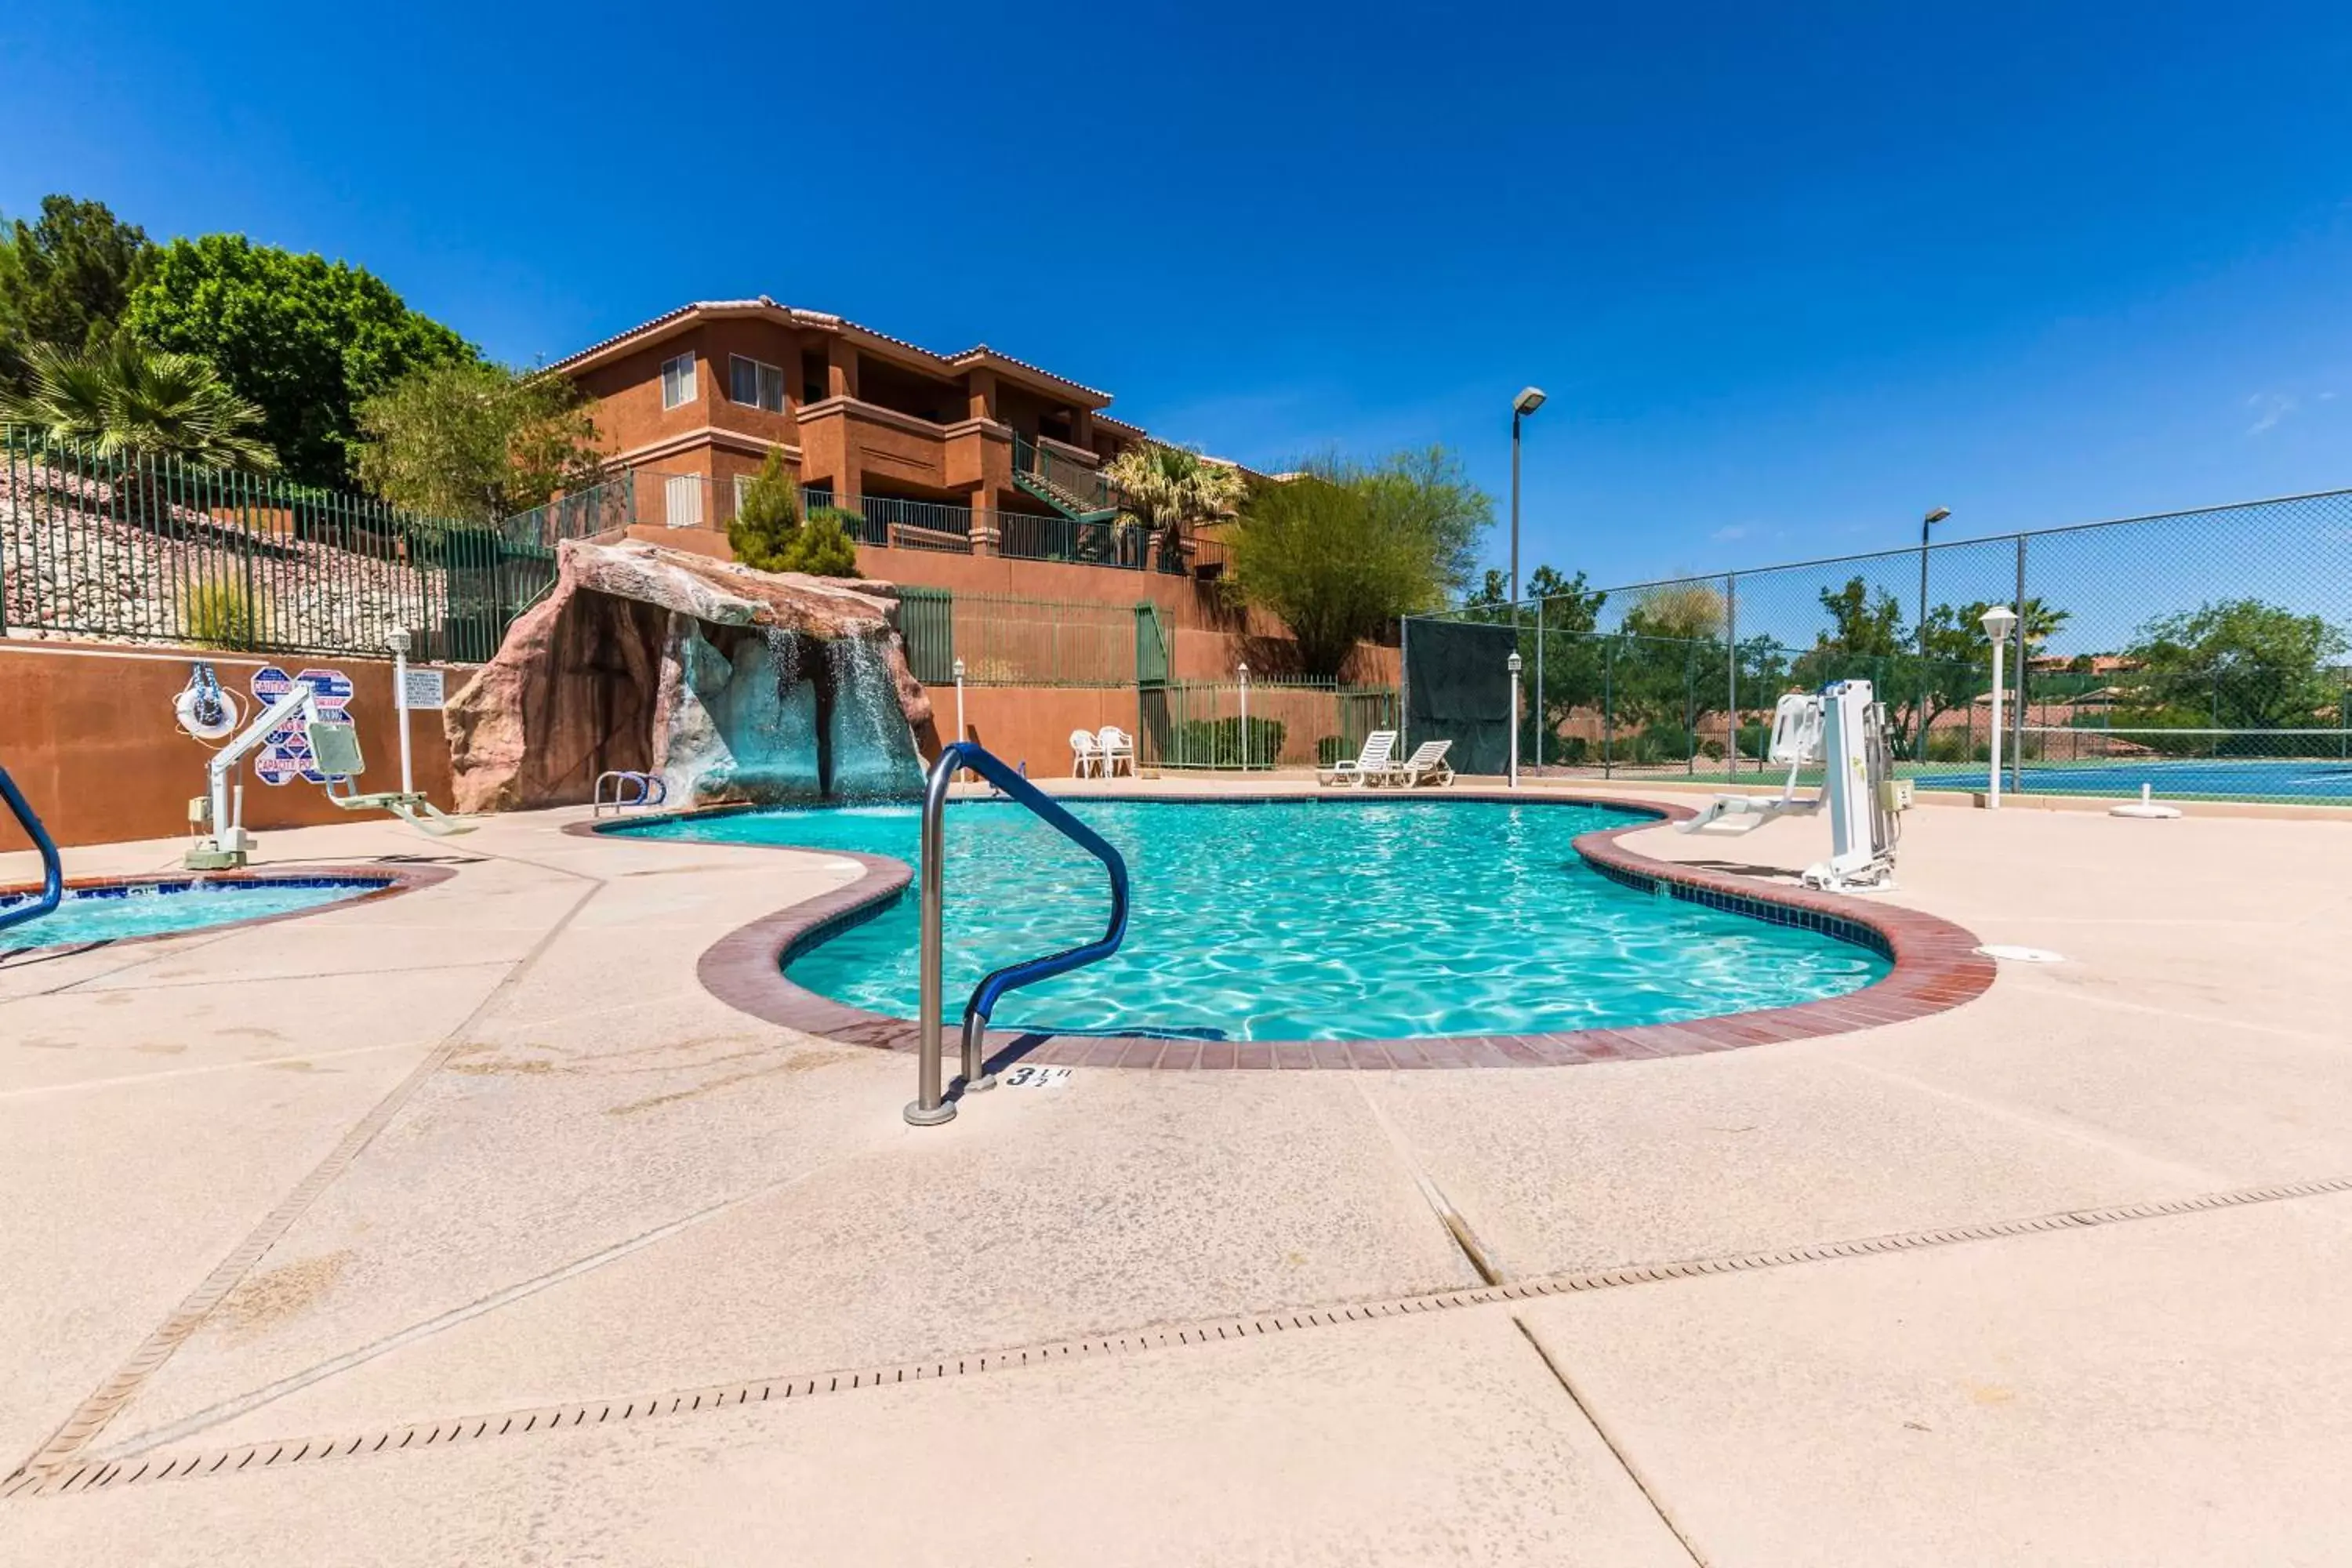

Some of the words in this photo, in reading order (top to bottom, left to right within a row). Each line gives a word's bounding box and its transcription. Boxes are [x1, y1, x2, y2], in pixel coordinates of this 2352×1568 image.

[254, 681, 293, 692] CAUTION
[257, 760, 295, 770] CAPACITY
[1006, 1067, 1035, 1085] 3
